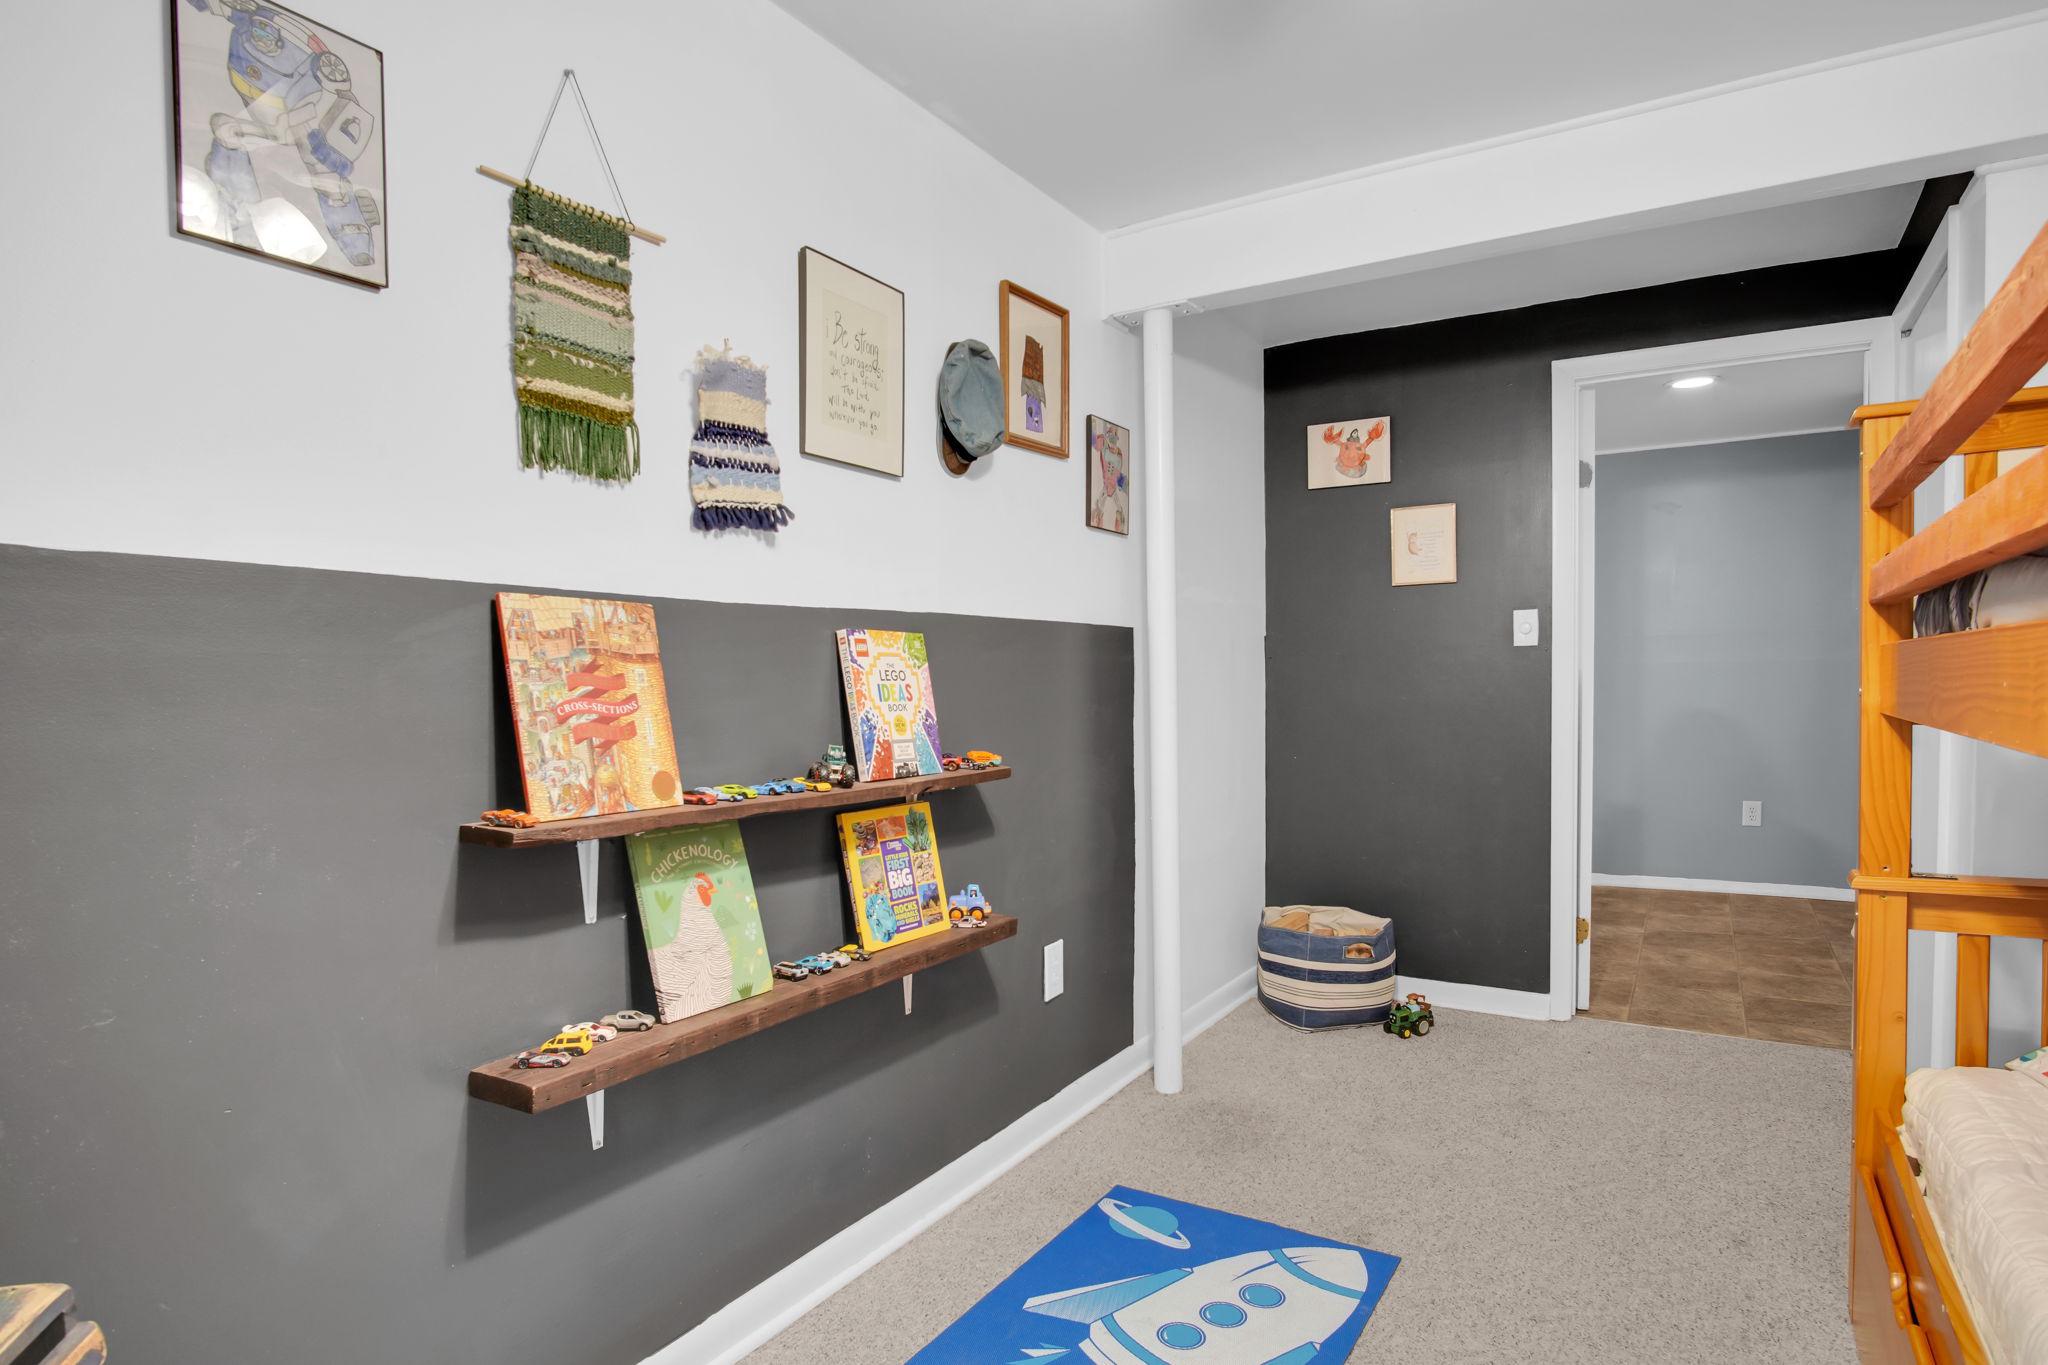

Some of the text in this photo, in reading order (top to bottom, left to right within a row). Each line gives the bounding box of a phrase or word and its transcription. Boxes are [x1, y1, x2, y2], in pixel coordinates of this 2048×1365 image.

[855, 328, 879, 371] strong
[879, 669, 906, 682] LEGO
[877, 683, 913, 702] IDEAS
[557, 700, 638, 716] CROSS-SECTIONS
[888, 703, 908, 713] BOOK
[650, 843, 740, 884] CHICKENOLOGY
[887, 858, 909, 871] FIRST
[892, 885, 913, 899] BOOK
